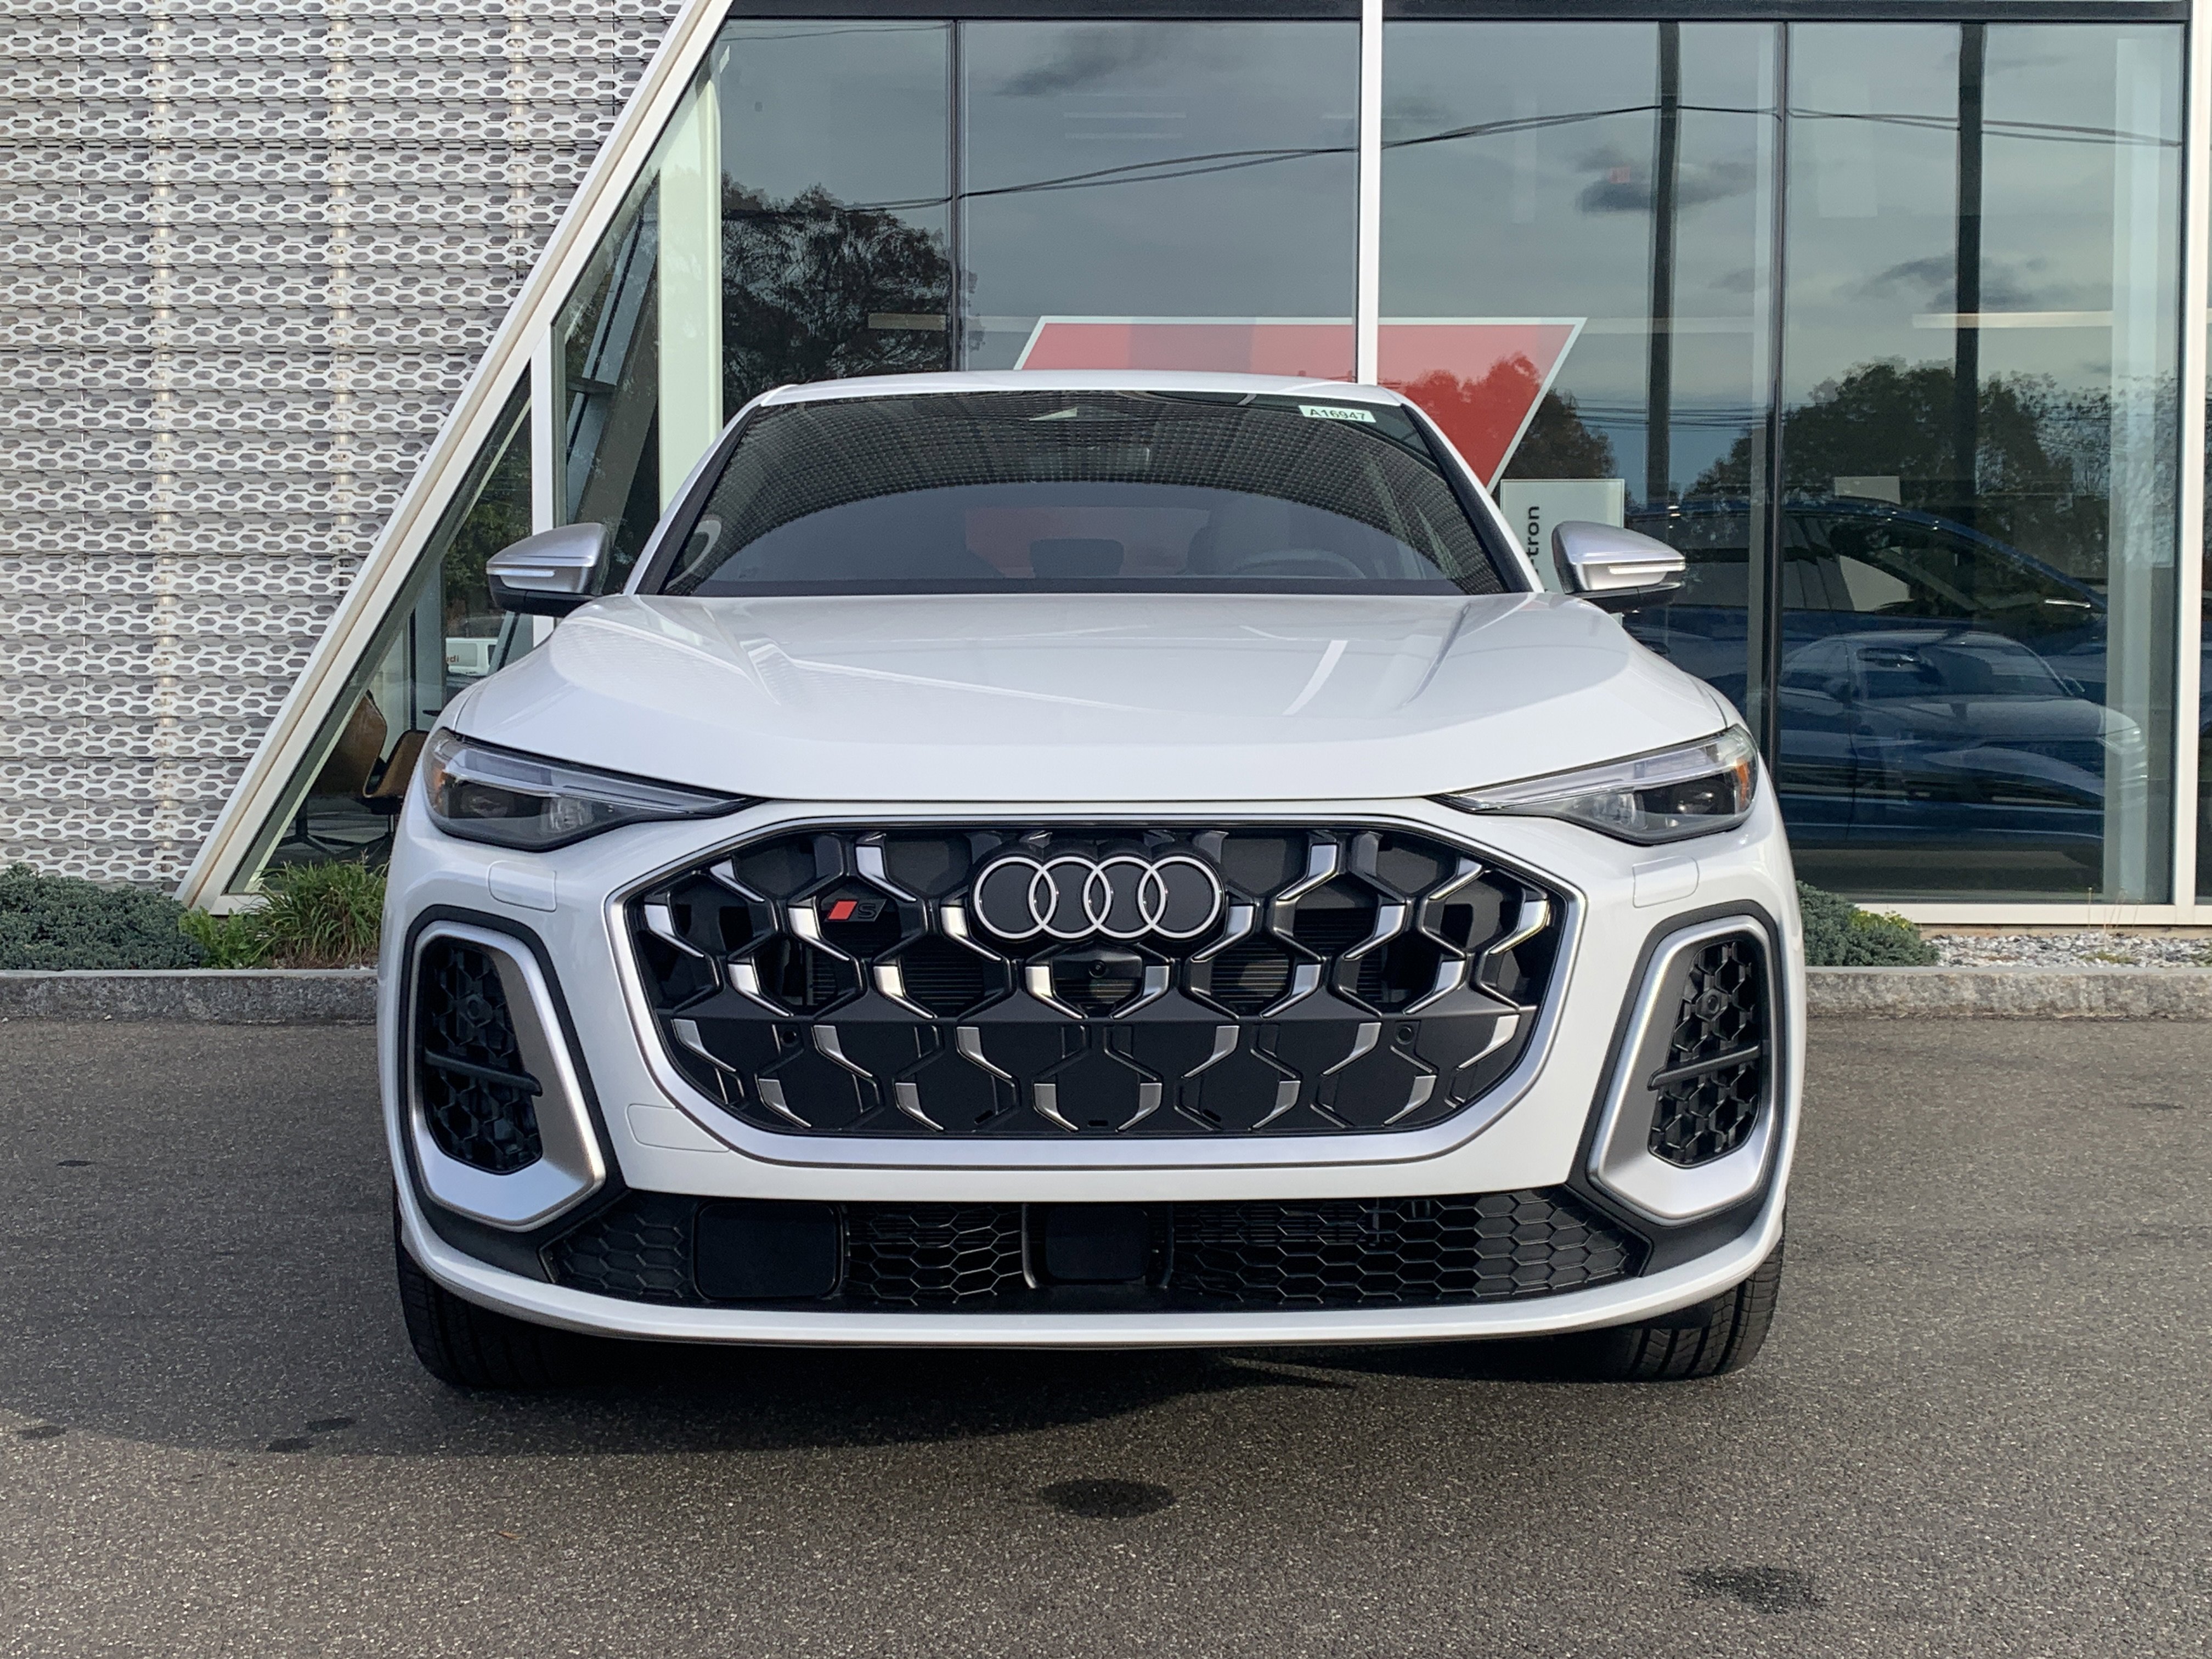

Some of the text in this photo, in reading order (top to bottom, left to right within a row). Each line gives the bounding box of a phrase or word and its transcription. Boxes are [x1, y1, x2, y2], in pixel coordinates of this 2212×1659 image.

[1310, 408, 1365, 421] A16947
[1526, 505, 1540, 575] -tron
[445, 654, 459, 663] udi
[857, 902, 877, 919] S
